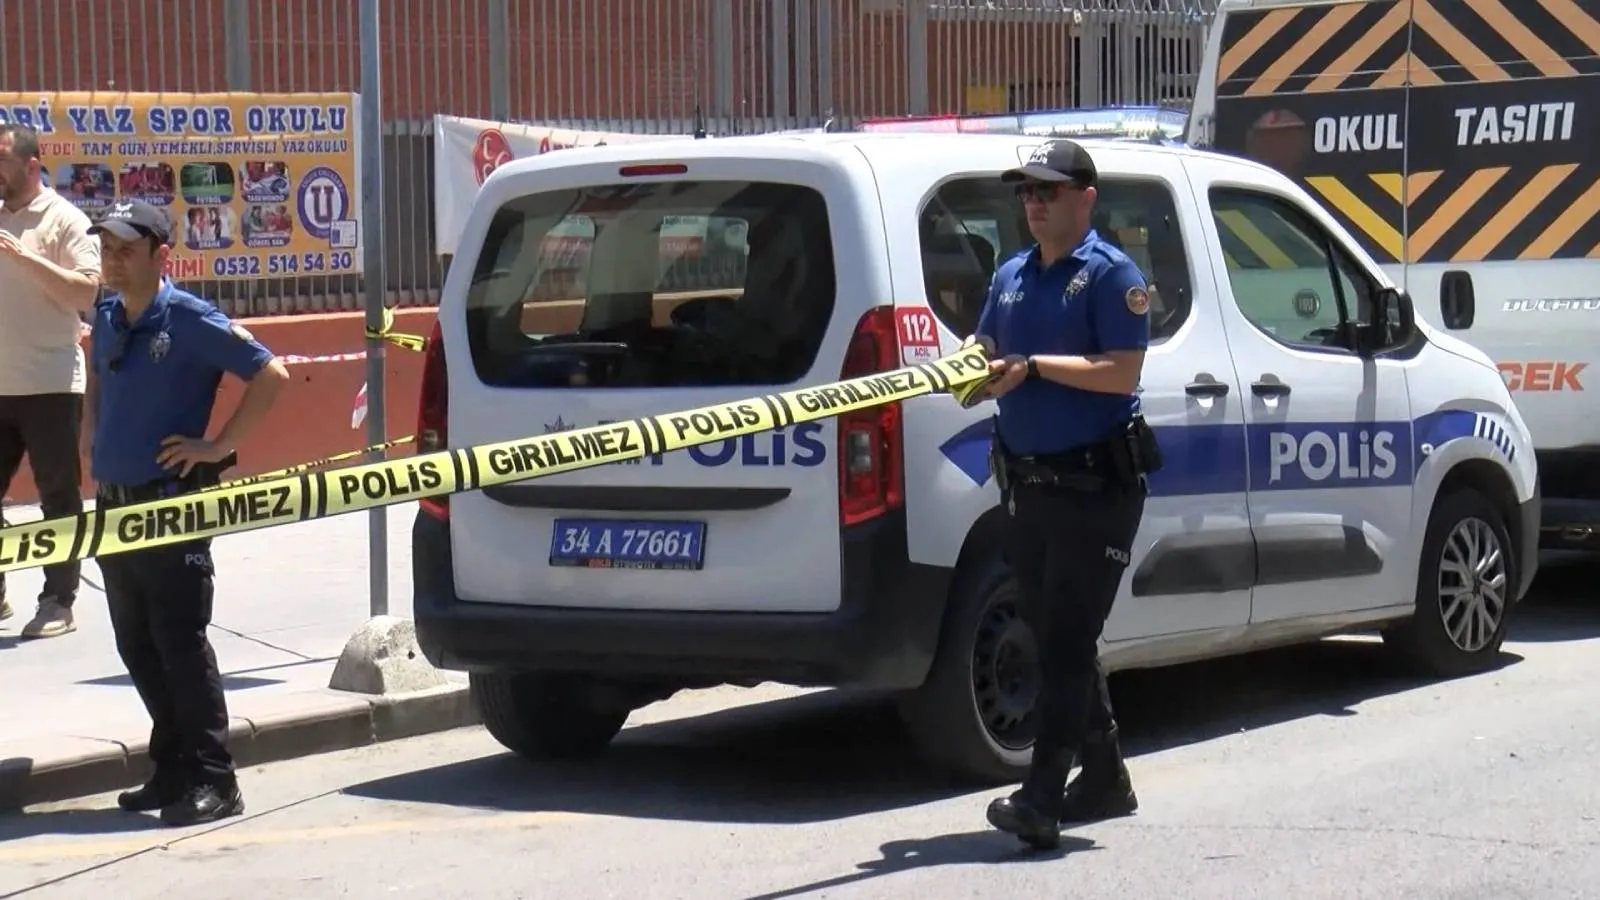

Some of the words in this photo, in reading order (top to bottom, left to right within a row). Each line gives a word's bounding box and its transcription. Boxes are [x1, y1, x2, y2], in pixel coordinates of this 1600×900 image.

[68, 107, 135, 133] YAZ
[149, 107, 232, 133] SPOR
[247, 106, 346, 132] OKULU
[1314, 113, 1403, 153] OKUL
[1455, 102, 1575, 146] TAŞITI
[81, 142, 112, 156] TAM
[214, 256, 260, 276] 0532
[268, 254, 298, 274] 514
[304, 254, 324, 272] 54
[331, 252, 352, 270] 30
[903, 313, 934, 342] 112
[945, 354, 986, 376] PO
[561, 527, 591, 553] 34
[595, 529, 612, 556] A
[621, 529, 693, 557] 77661
